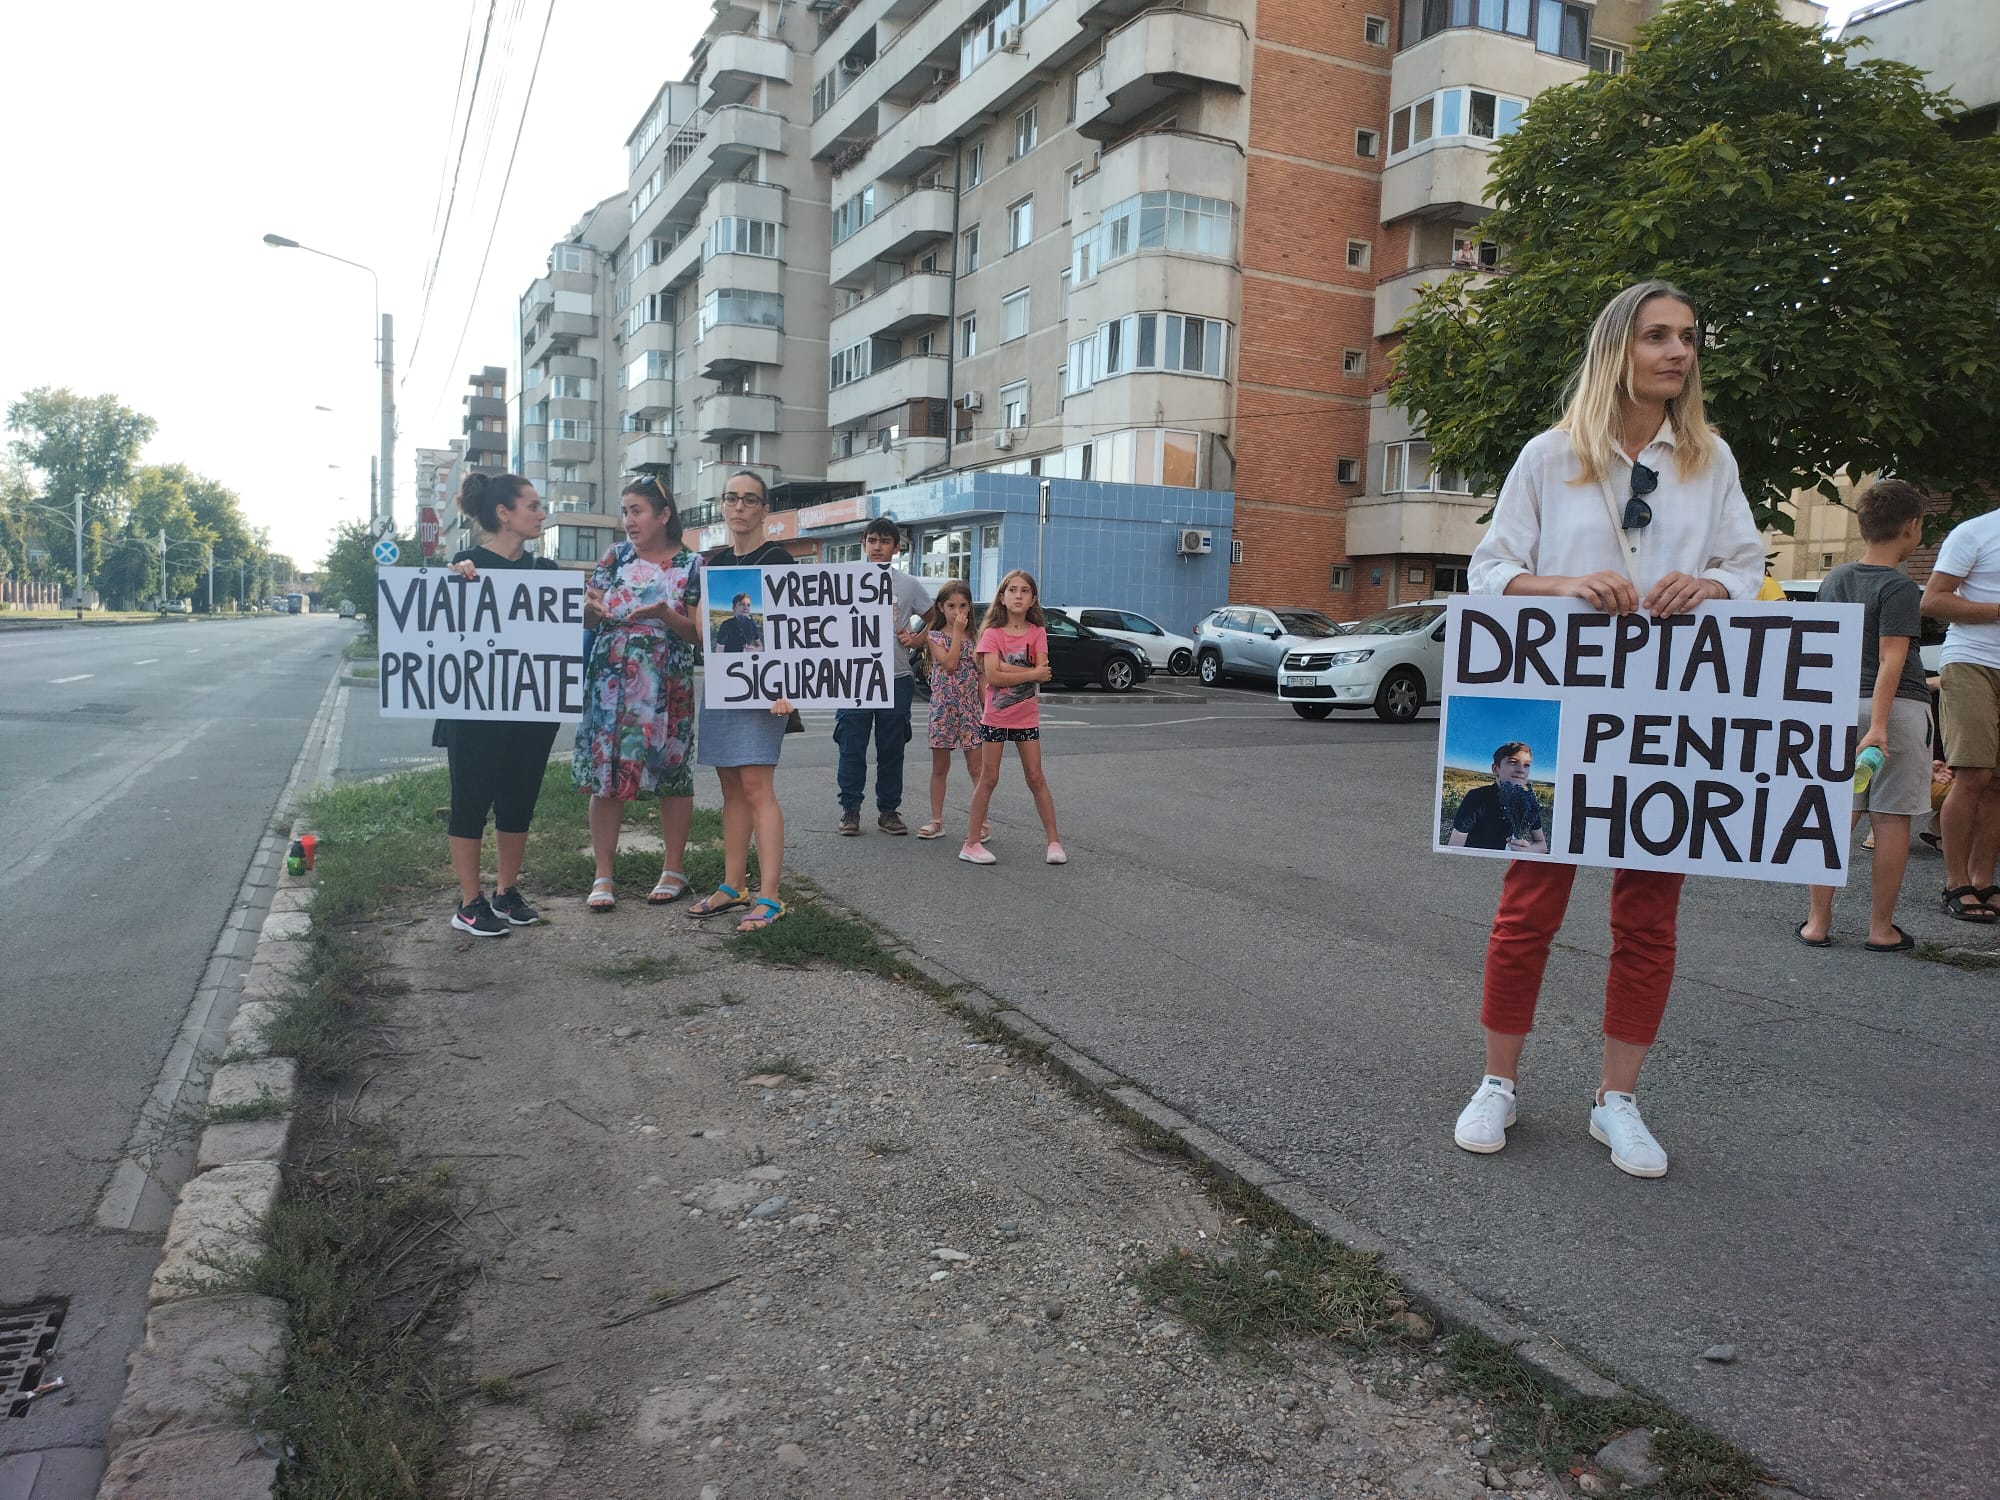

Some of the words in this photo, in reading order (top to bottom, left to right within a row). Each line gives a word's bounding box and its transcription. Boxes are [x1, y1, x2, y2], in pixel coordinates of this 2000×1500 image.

[508, 583, 583, 623] ARE
[765, 570, 853, 607] VREAU
[858, 563, 893, 605] SĂ
[767, 613, 839, 649] TREC
[849, 606, 880, 648] ÎN
[382, 639, 583, 713] PRIORITATE
[1457, 608, 1840, 704] DREPTATE
[1582, 713, 1858, 782] PENTRU
